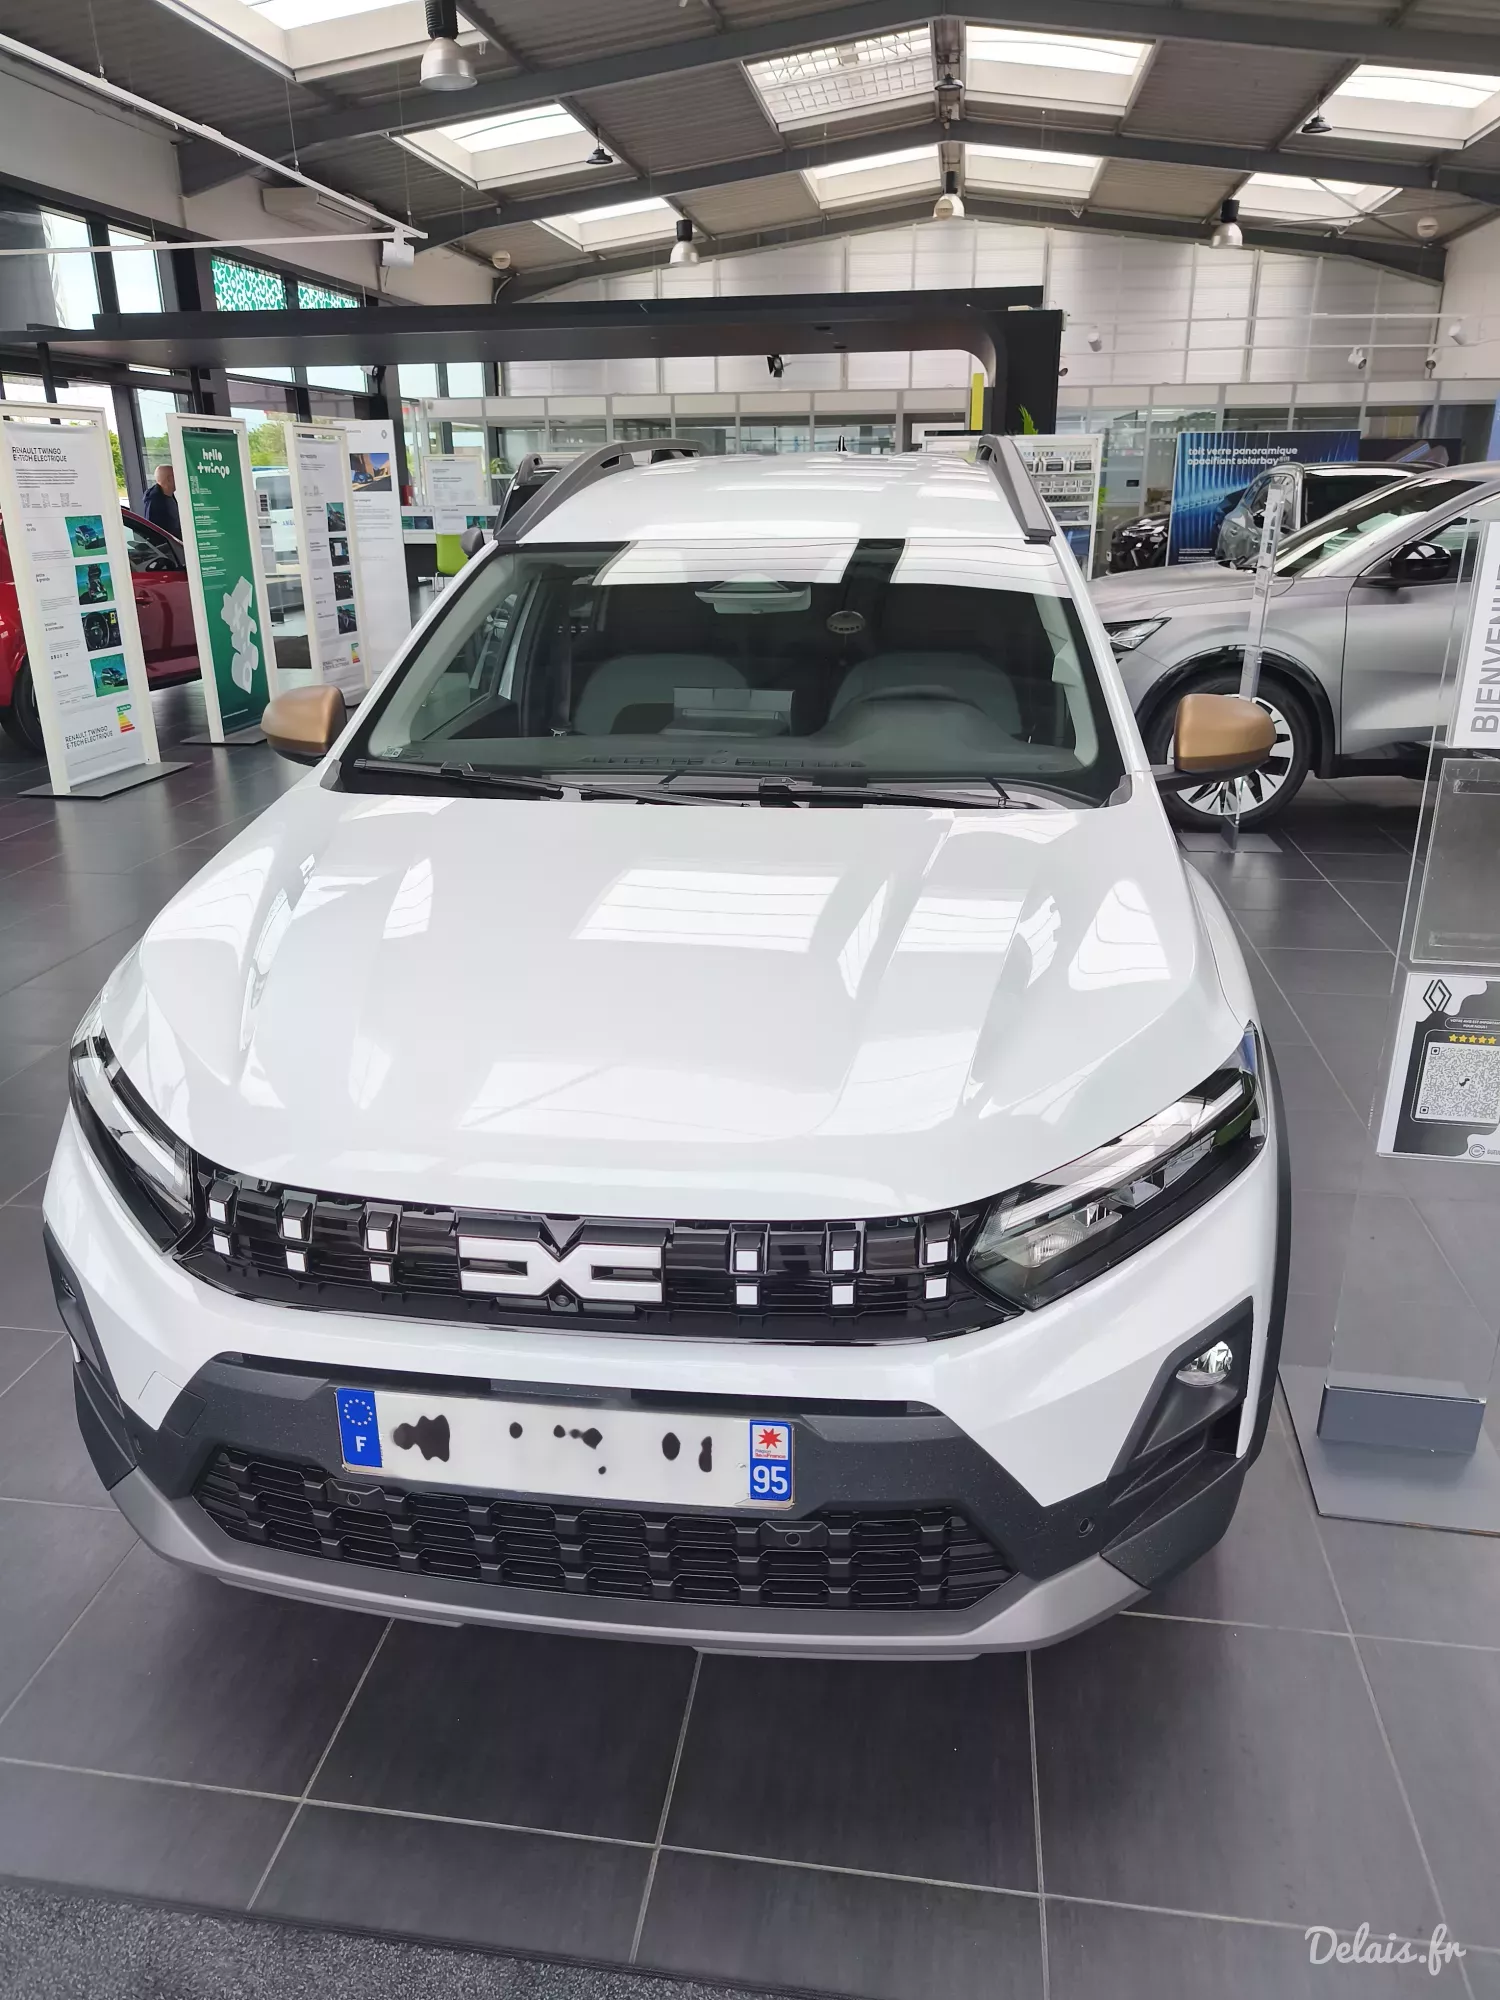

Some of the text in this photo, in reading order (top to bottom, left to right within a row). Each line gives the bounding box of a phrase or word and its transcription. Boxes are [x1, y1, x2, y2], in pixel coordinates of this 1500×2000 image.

[202, 448, 222, 461] hello
[1188, 446, 1205, 455] toit
[1233, 446, 1298, 458] panoramique
[1187, 456, 1236, 467] opacifiant
[197, 461, 230, 479] twingo
[65, 726, 108, 742] RENAULT TWINGO
[356, 1436, 367, 1452] F
[753, 1465, 788, 1494] 95
